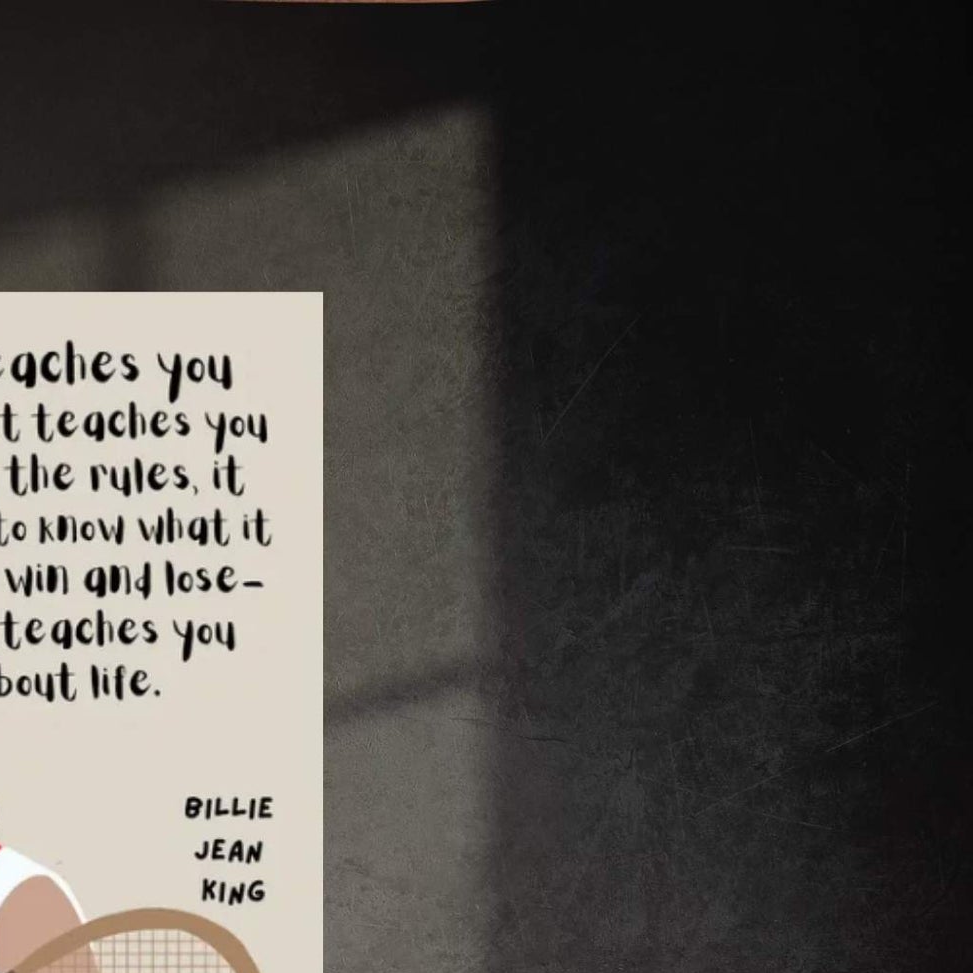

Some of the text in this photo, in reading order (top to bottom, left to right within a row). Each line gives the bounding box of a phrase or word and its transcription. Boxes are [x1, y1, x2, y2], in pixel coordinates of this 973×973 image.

[157, 353, 232, 404] you
[33, 401, 190, 443] teaches
[205, 412, 267, 455] you
[6, 453, 74, 496] the
[90, 457, 198, 497] rules,
[213, 455, 244, 496] it
[39, 515, 124, 545] know
[137, 507, 230, 547] what
[243, 508, 271, 547] it
[4, 563, 69, 597] win
[84, 562, 151, 600] and
[0, 609, 158, 650] teaches
[173, 620, 235, 662] you
[91, 664, 160, 701] life.
[185, 796, 273, 820] BILLIE
[194, 839, 263, 864] JEAN
[202, 878, 265, 906] KING
